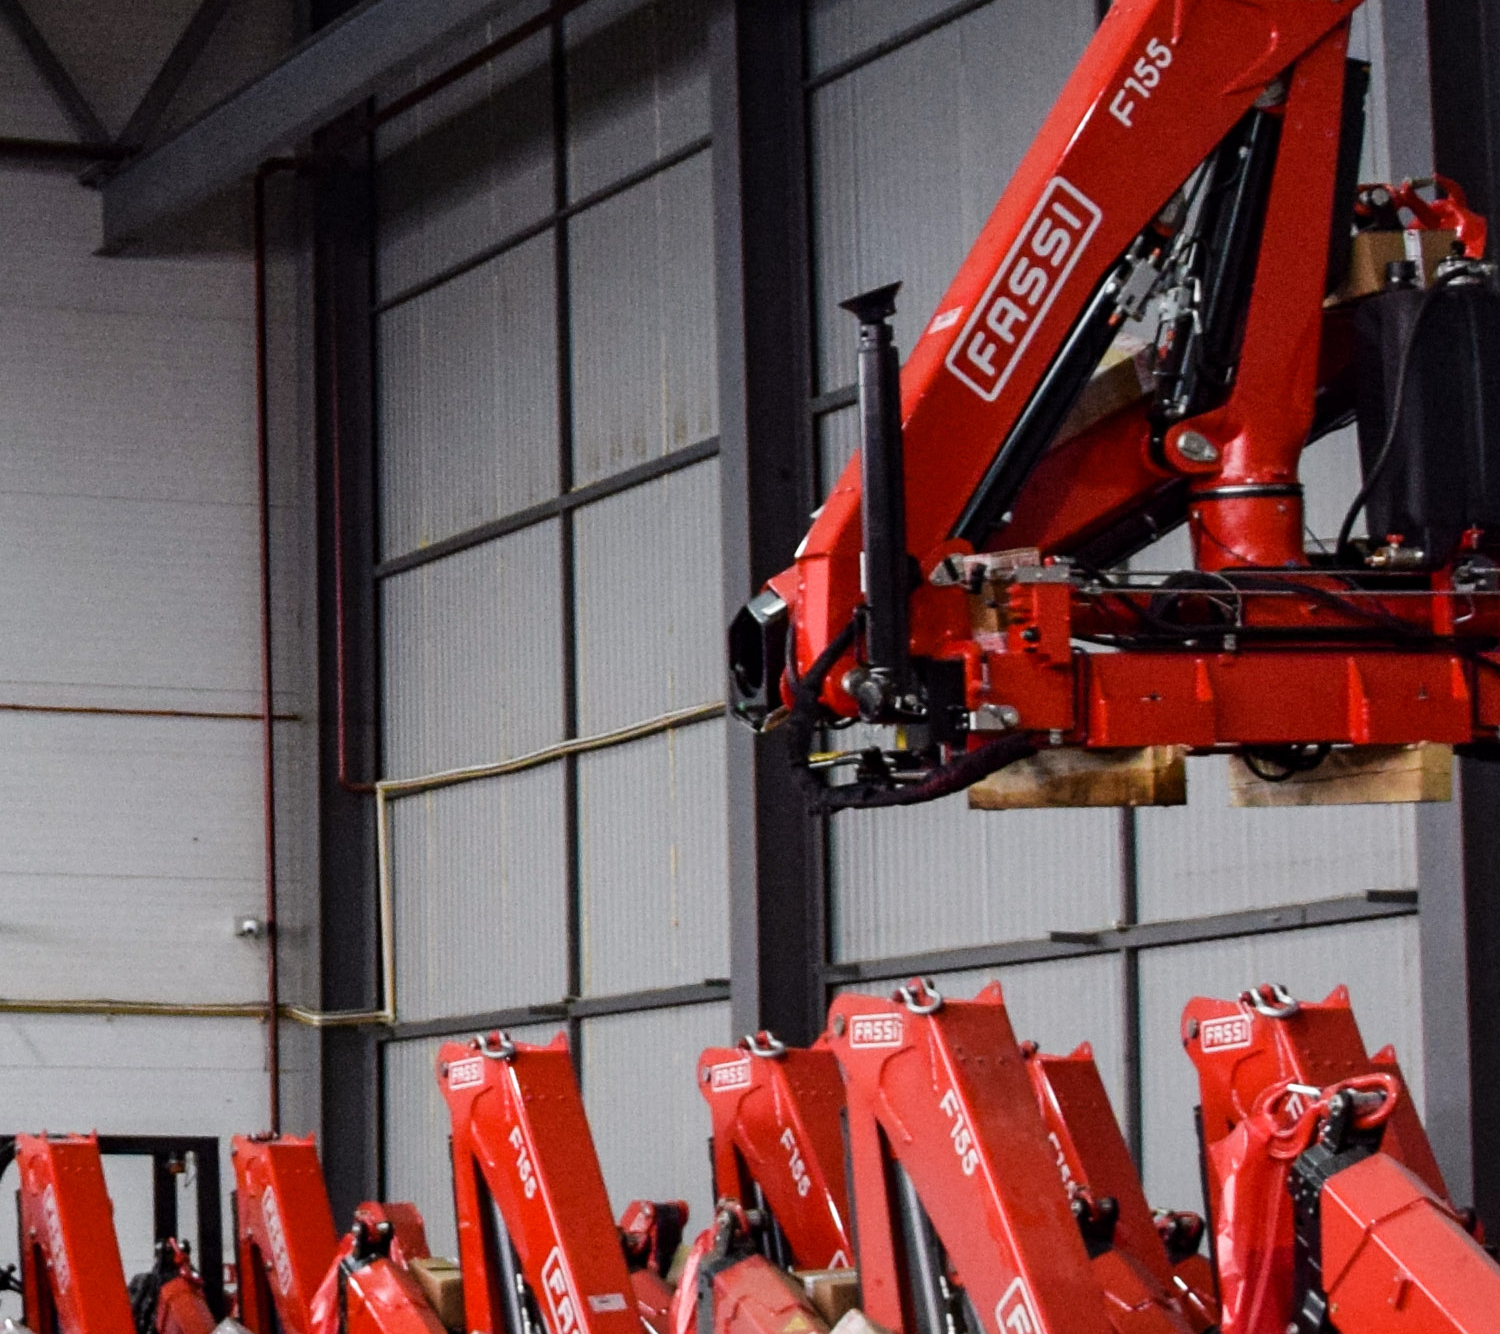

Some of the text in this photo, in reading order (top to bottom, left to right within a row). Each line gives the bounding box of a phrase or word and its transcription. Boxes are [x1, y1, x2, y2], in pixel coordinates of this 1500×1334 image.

[1109, 37, 1173, 127] F155
[966, 201, 1083, 376] FASSI
[939, 1088, 979, 1176] F155
